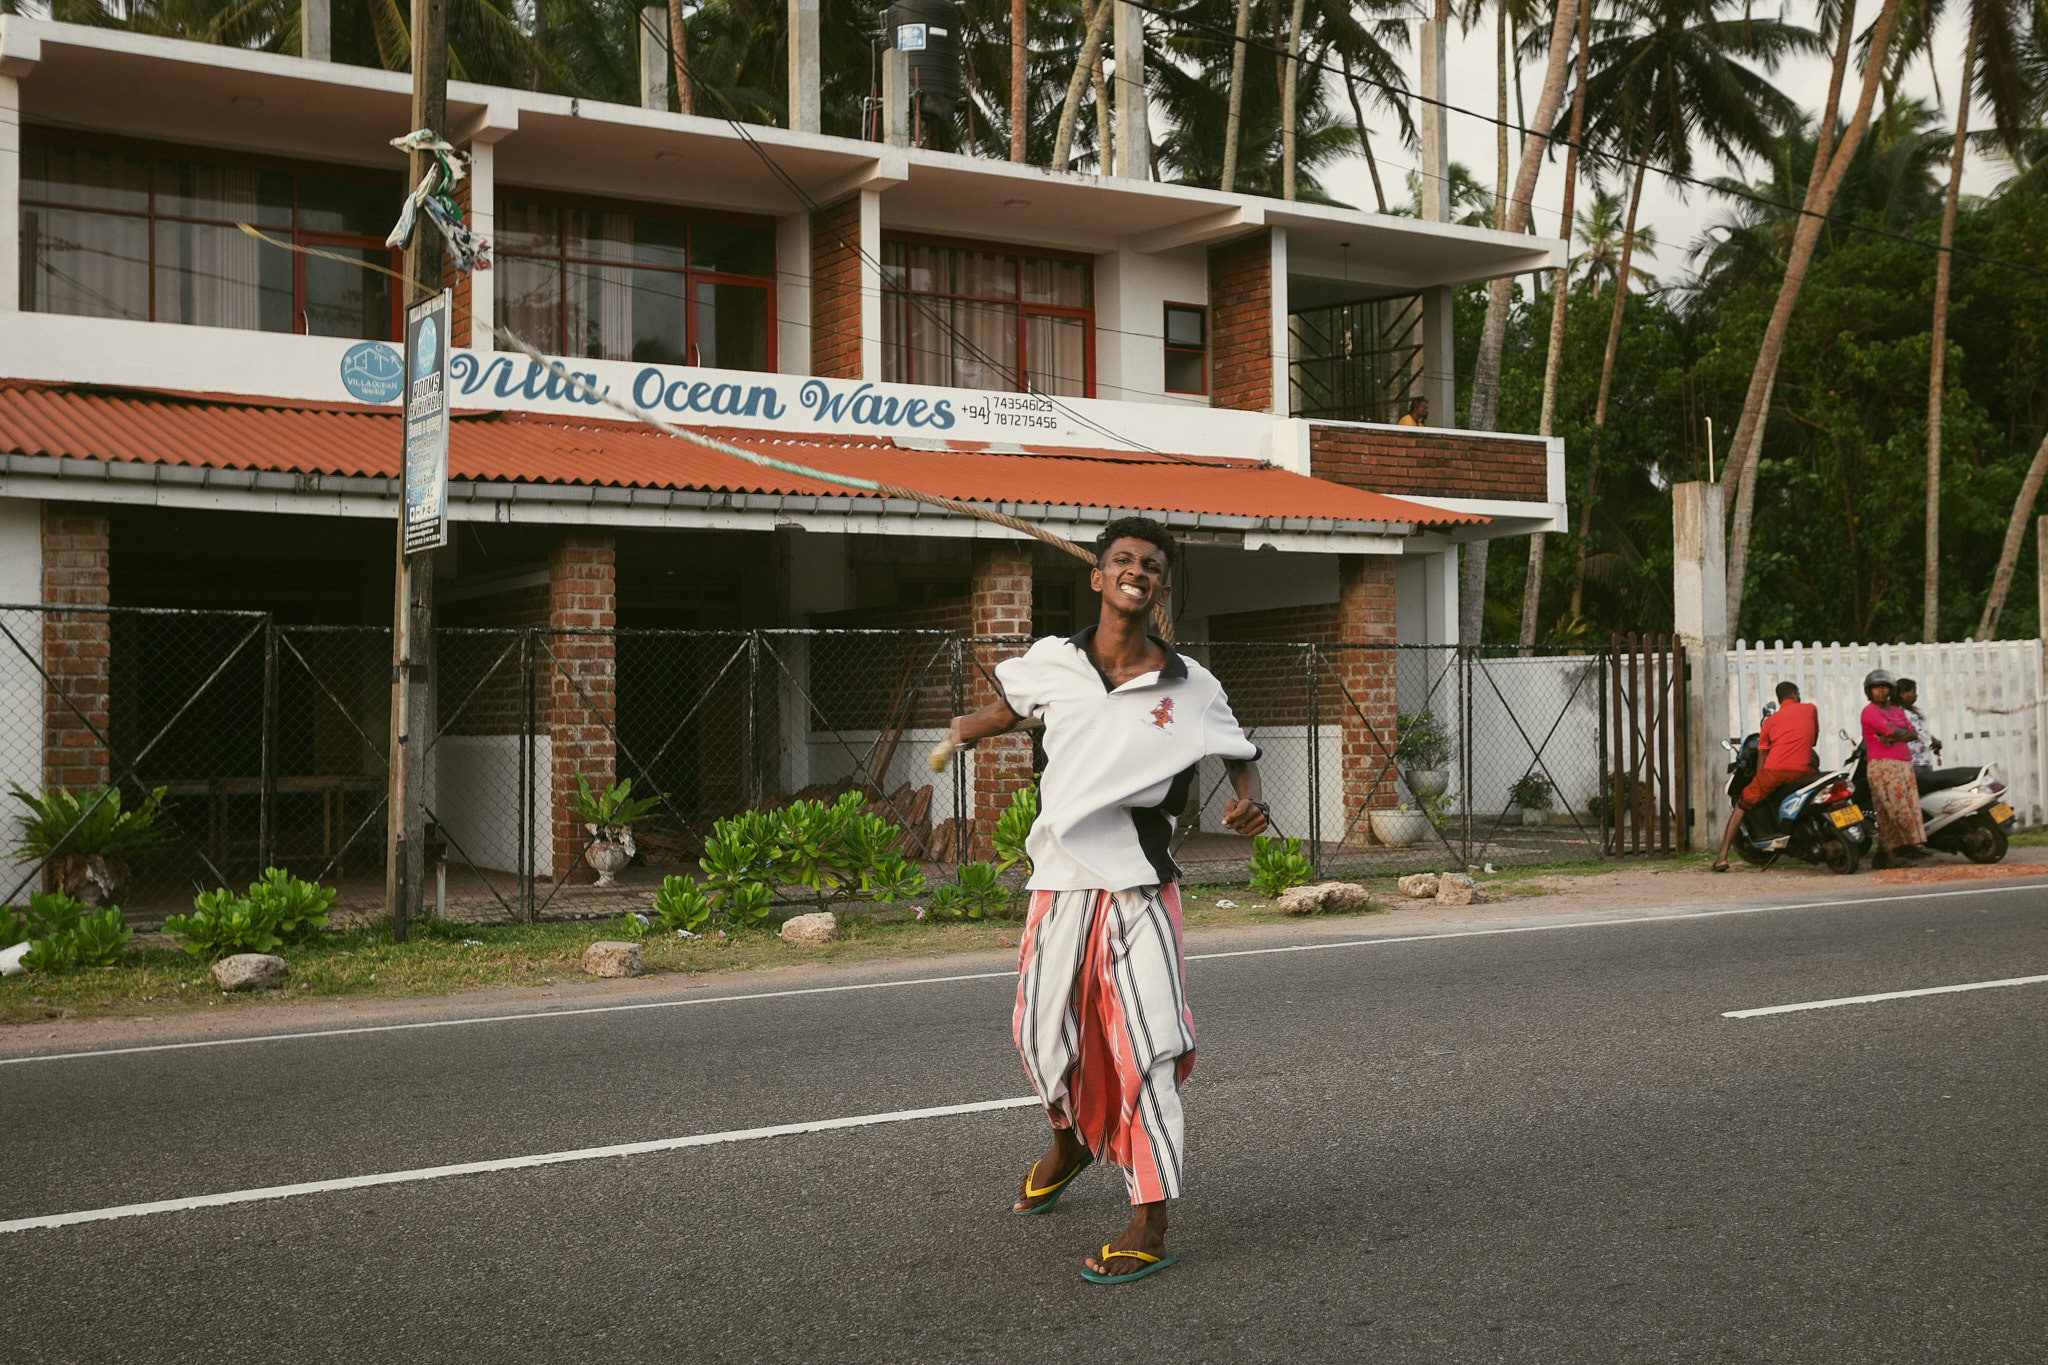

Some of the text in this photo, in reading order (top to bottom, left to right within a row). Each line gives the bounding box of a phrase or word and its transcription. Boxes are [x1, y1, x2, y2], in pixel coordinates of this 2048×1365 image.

[347, 377, 371, 388] VILLA
[413, 371, 440, 401] ROOMS
[450, 353, 956, 430] Villa Ocean Waves
[408, 391, 443, 421] AVAILABLE
[993, 396, 1053, 412] 743546123
[993, 413, 1057, 429] 787275456
